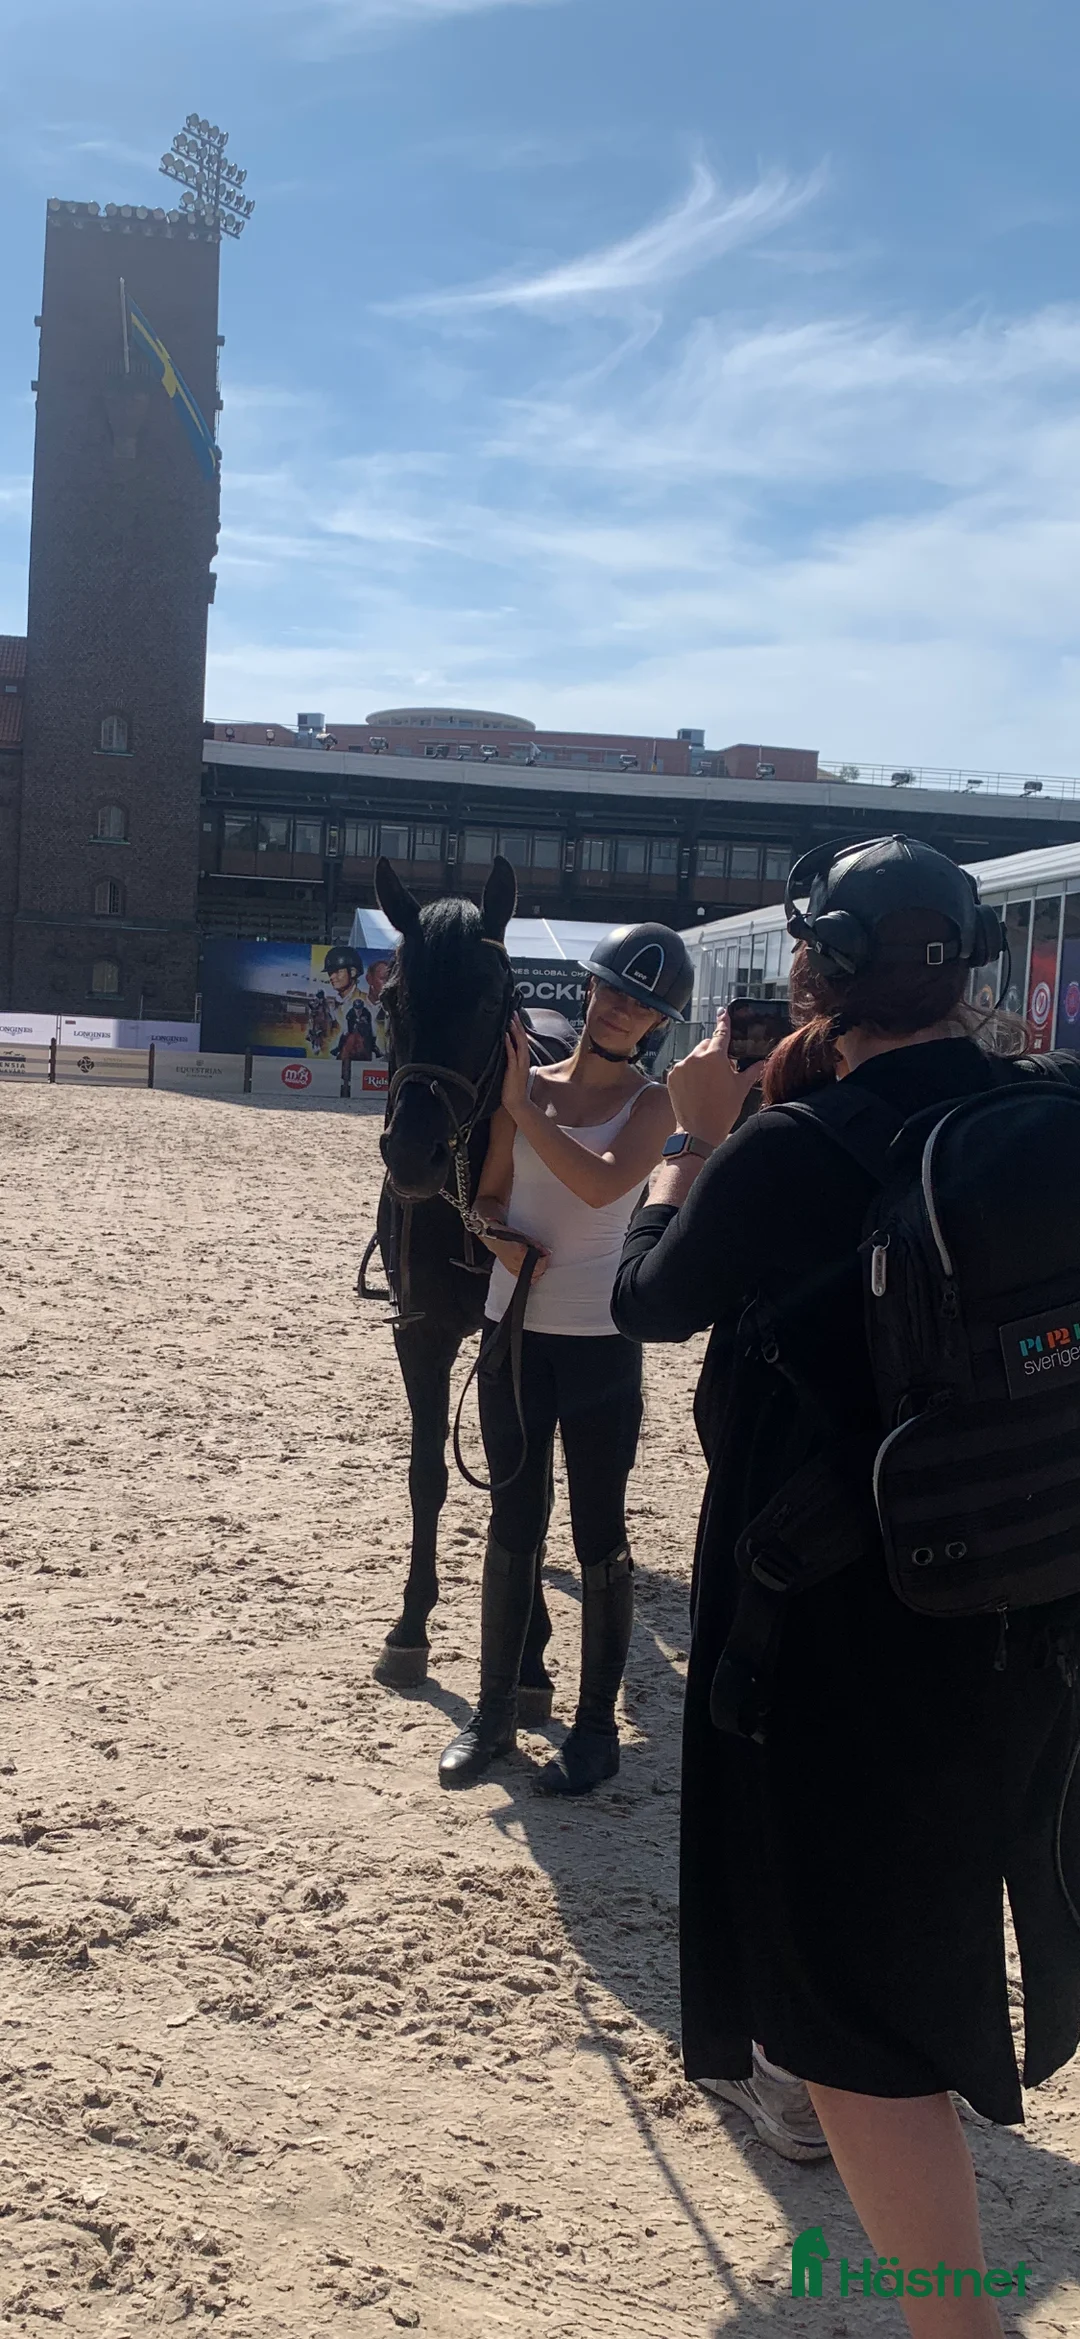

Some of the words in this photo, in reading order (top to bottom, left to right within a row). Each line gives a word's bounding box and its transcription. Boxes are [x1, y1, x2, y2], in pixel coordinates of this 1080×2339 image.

[532, 969, 568, 977] GLOBAL
[73, 1030, 111, 1039] LONGINES
[151, 1034, 189, 1043] LONGINES
[176, 1066, 222, 1075] EQUESTRIAN
[1019, 1335, 1043, 1357] P1
[1046, 1327, 1071, 1349] P2
[1024, 1346, 1080, 1375] sverige
